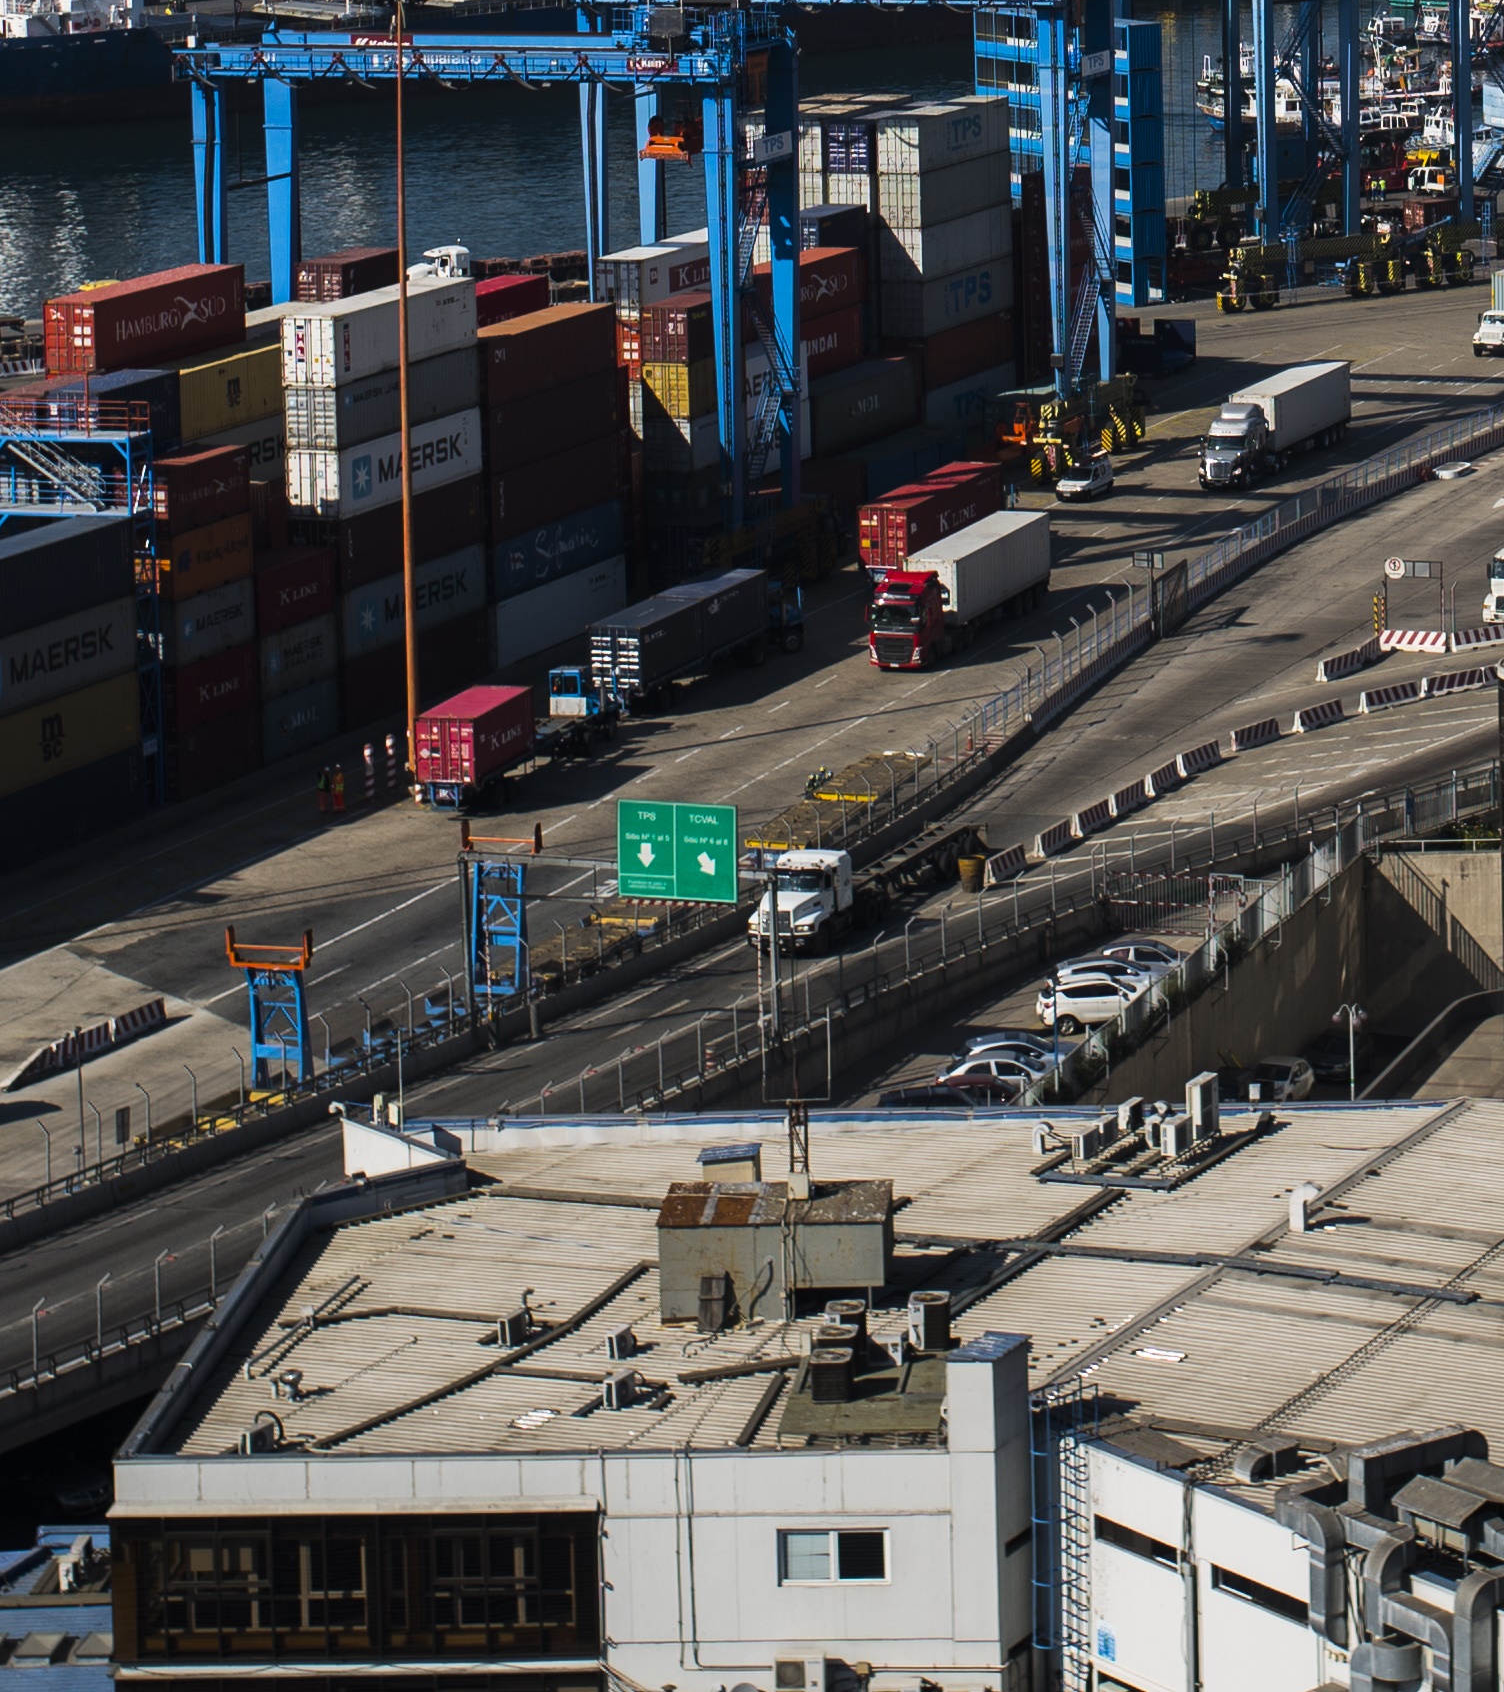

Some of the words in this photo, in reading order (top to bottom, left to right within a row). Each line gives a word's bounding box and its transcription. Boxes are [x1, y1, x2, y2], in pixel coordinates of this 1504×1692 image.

[951, 113, 982, 144] TPS
[763, 135, 785, 152] TPS
[950, 271, 992, 312] TPS
[116, 309, 178, 342] HAMBURG
[199, 296, 226, 319] SÜD
[856, 393, 881, 416] MOL
[952, 503, 977, 526] LINE
[197, 535, 248, 564] Hapag-Lloyd
[535, 524, 599, 579] Safmarine
[293, 581, 319, 602] LINE
[196, 603, 245, 633] MAERSK
[10, 623, 114, 686] MAERSK
[283, 634, 324, 656] MAERSK
[213, 677, 241, 697] LINE
[501, 724, 523, 745] LINE
[637, 811, 656, 822] TPS
[689, 813, 719, 825] TCVAL
